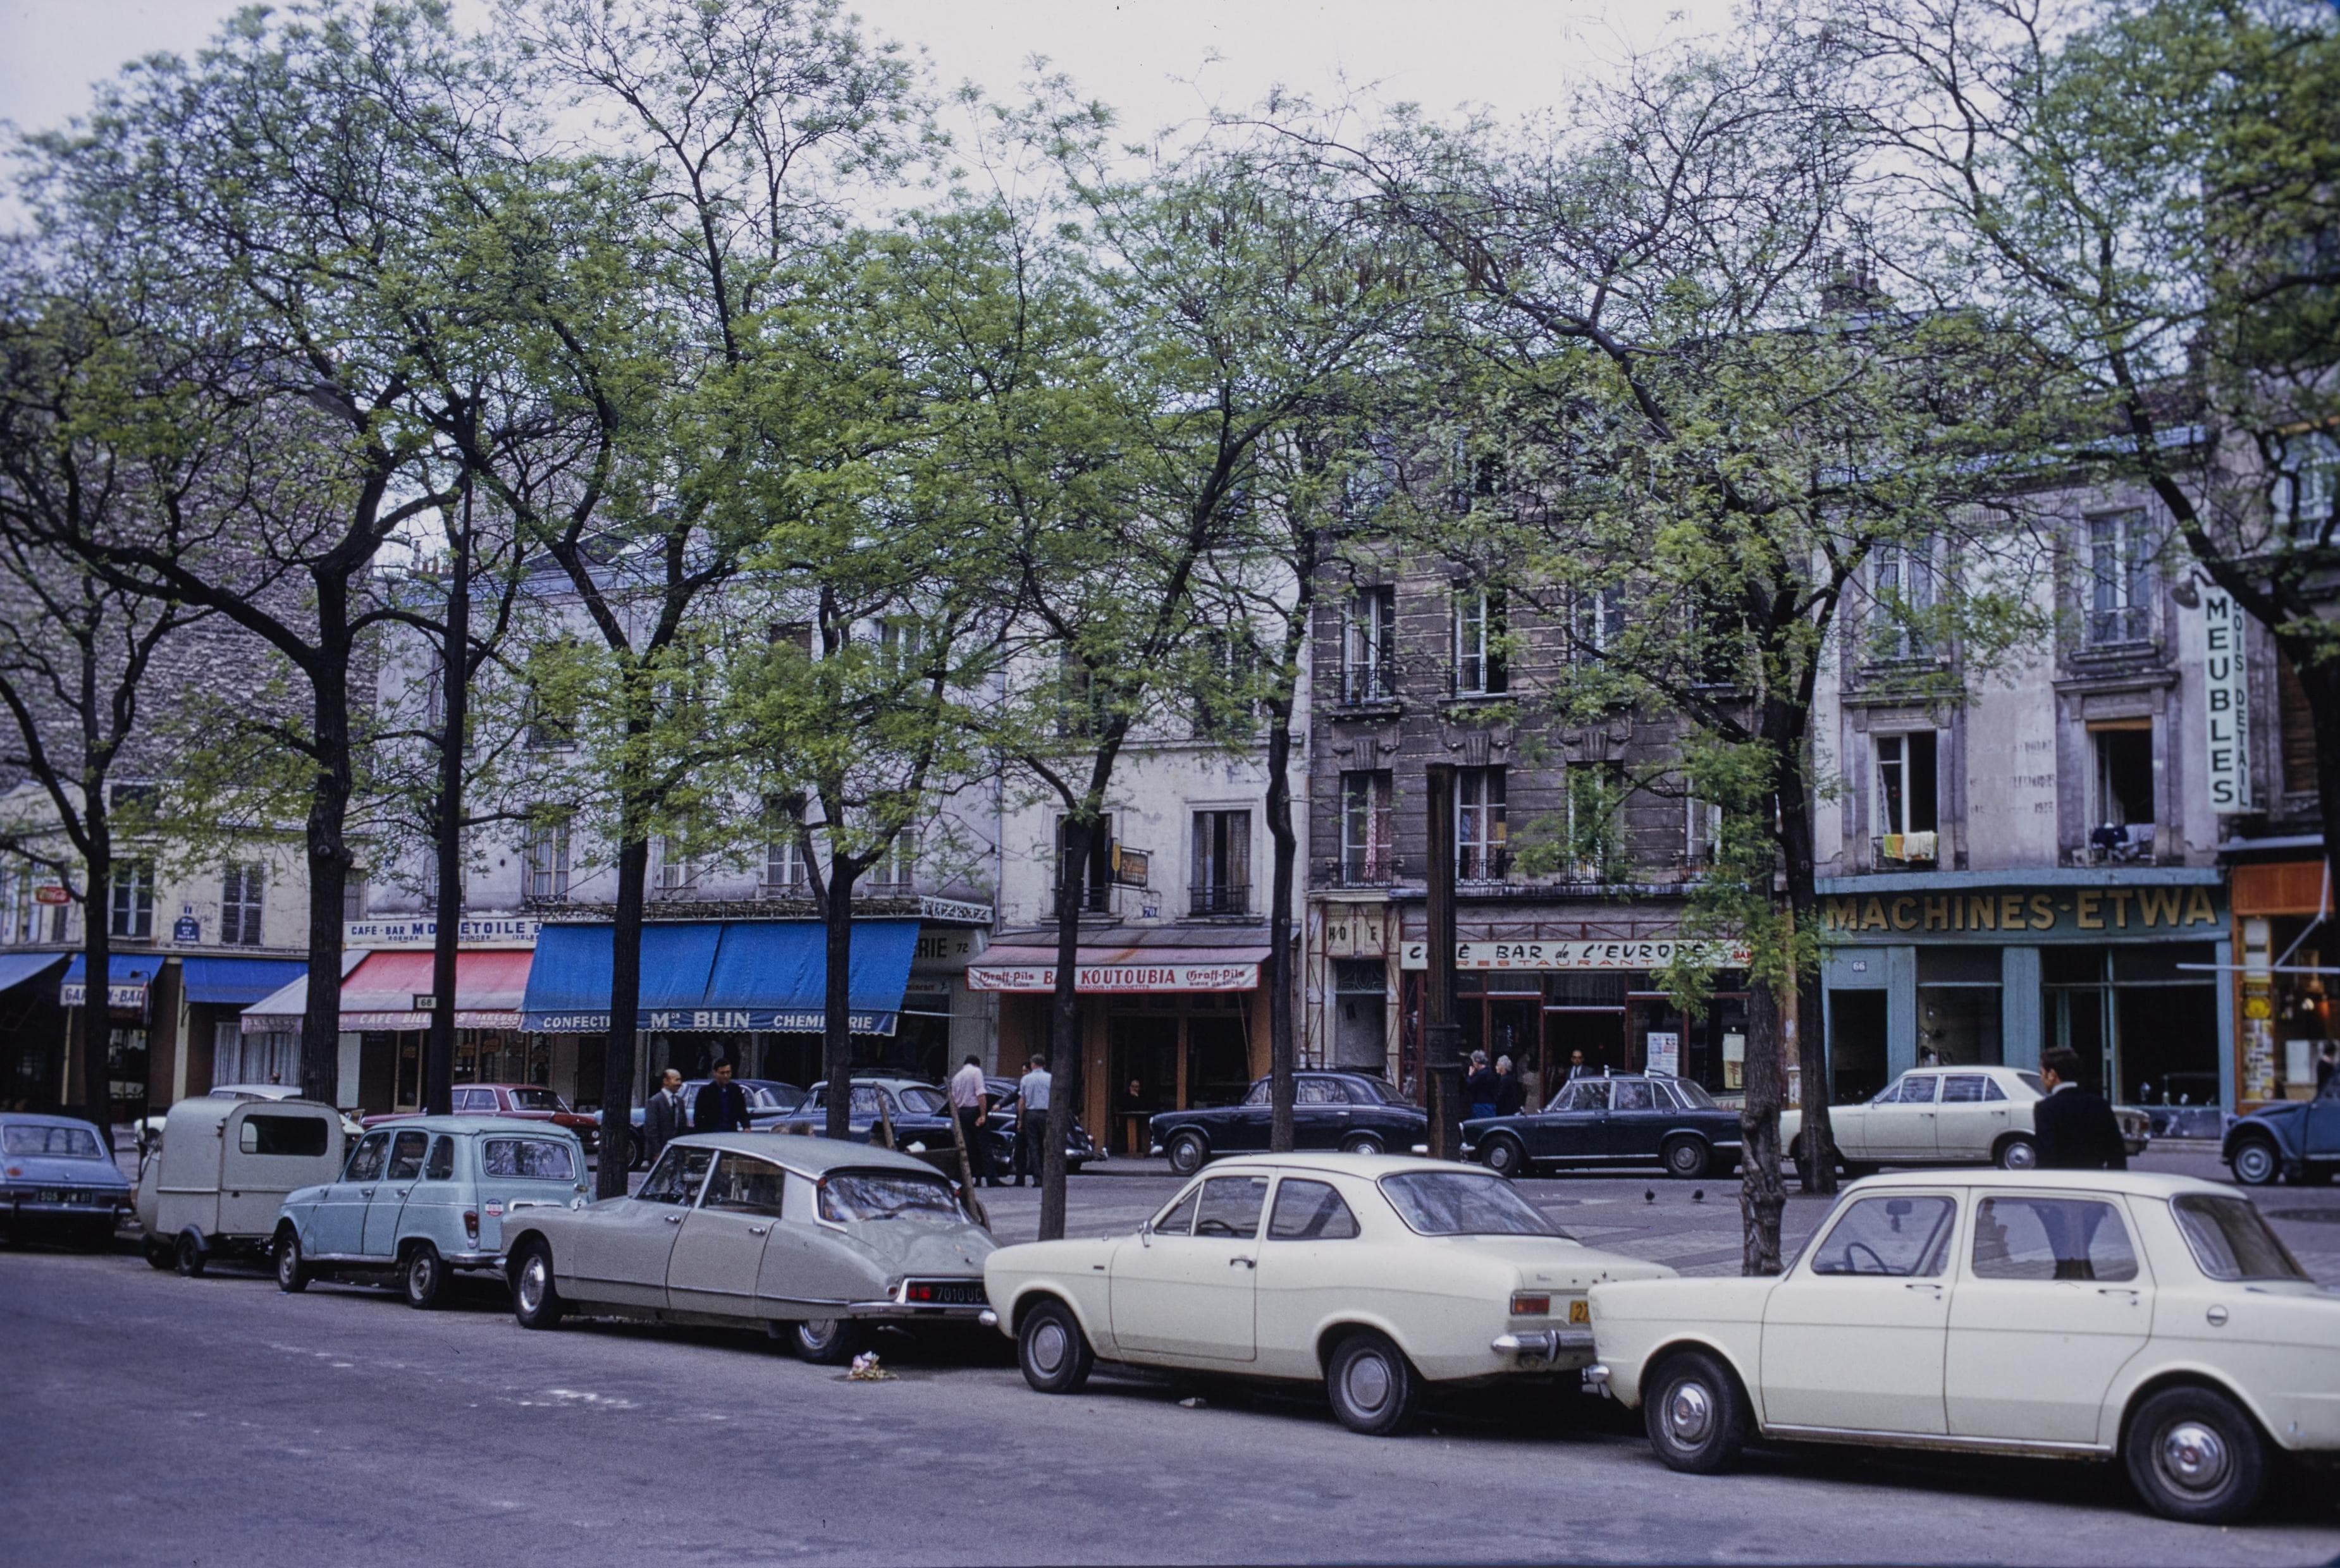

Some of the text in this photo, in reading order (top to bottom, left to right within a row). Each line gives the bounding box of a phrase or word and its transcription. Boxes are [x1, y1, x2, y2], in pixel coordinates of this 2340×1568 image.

[2206, 597, 2233, 804] MEUBLES
[1145, 907, 1155, 917] 70
[956, 943, 968, 953] 72
[1496, 945, 1543, 959] BAR
[1555, 944, 1570, 959] de
[1853, 962, 1866, 971] 66
[1081, 969, 1176, 984] KOUTOUBIA
[421, 997, 433, 1007] 68
[543, 1016, 611, 1028] CONFECTI
[694, 1012, 750, 1028] BLIN
[773, 1015, 872, 1029] CHEMIRIE
